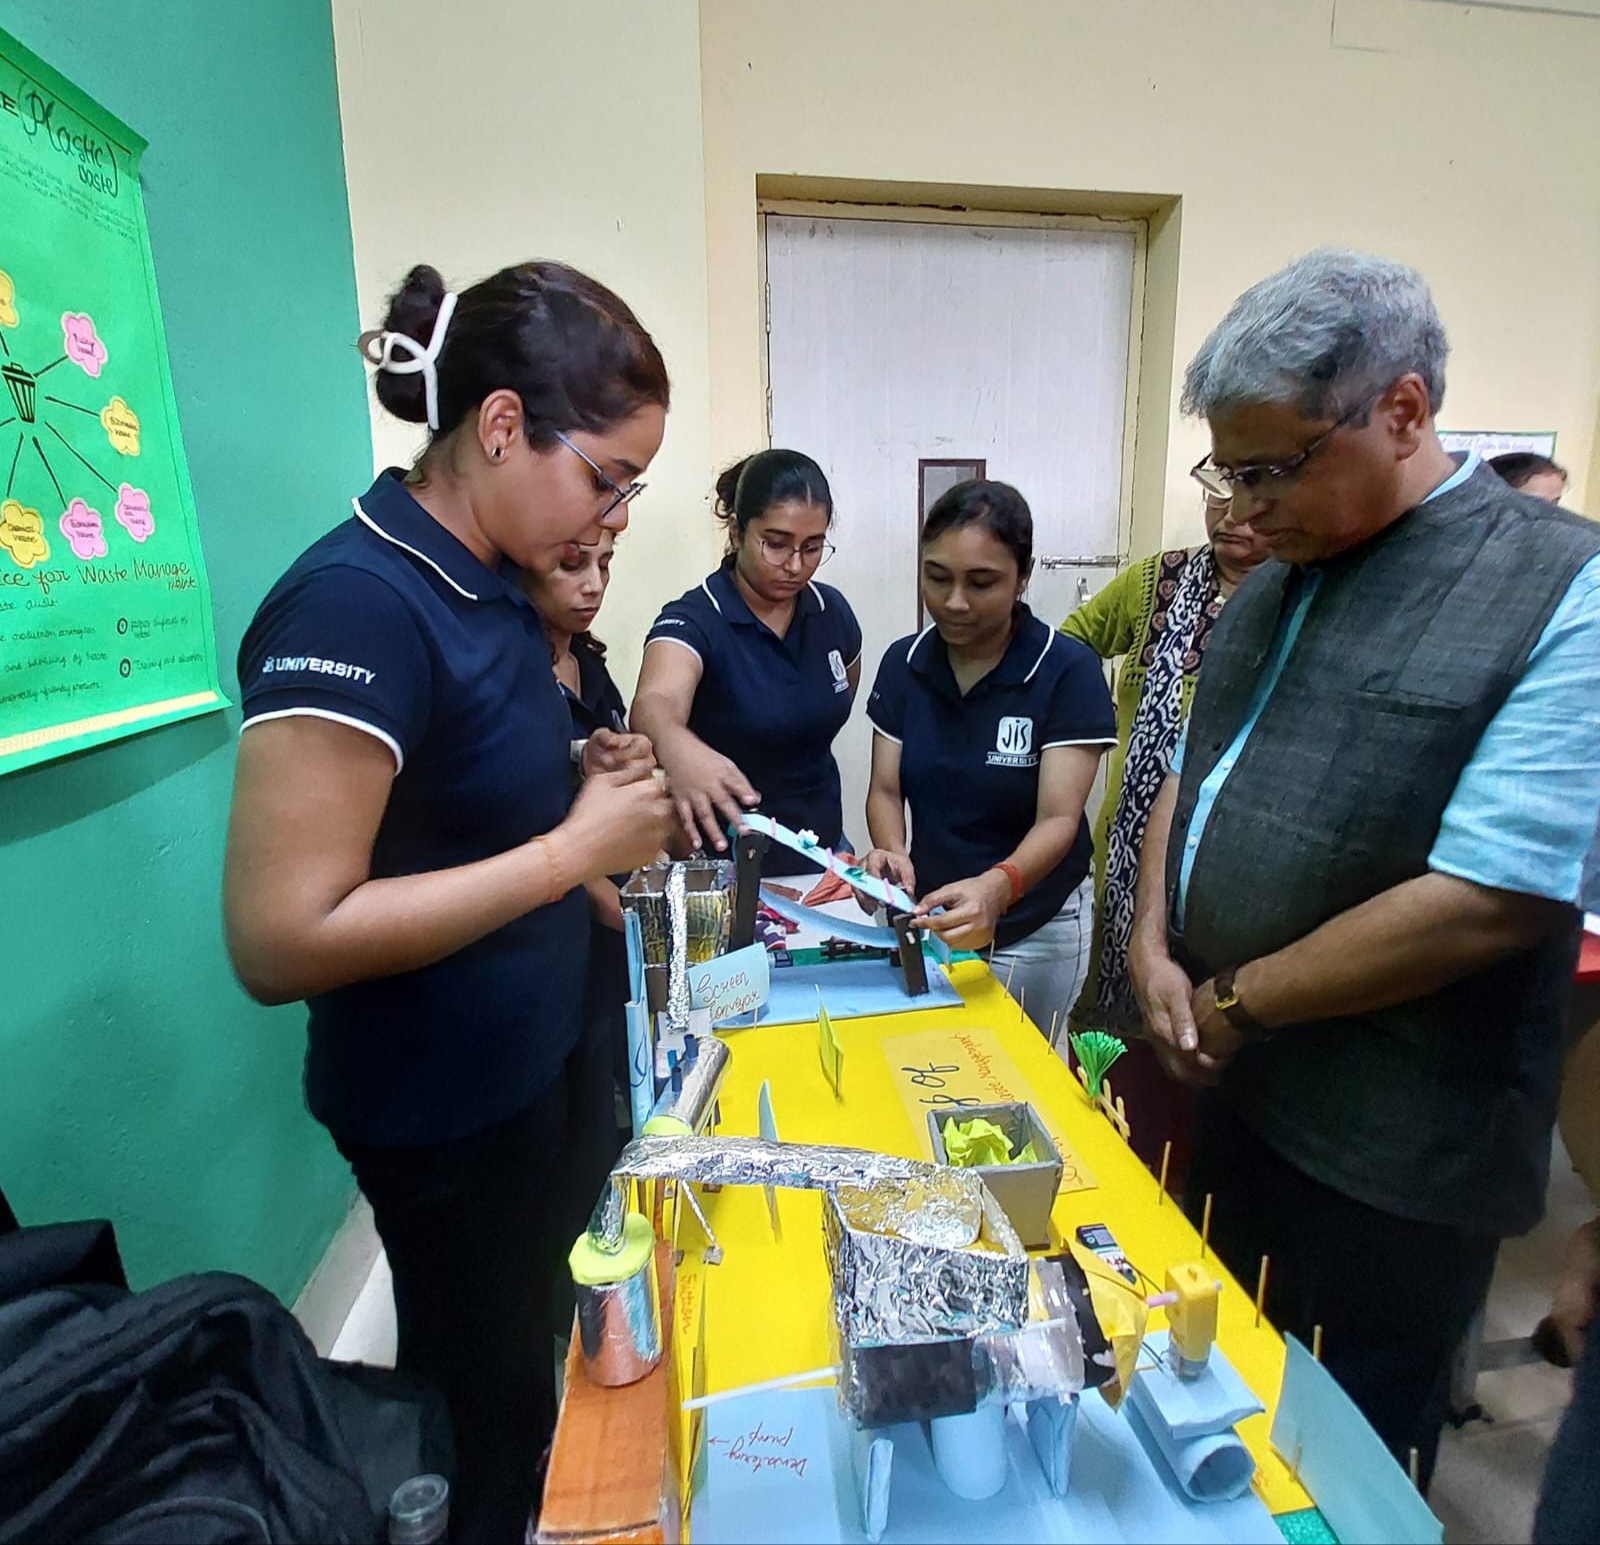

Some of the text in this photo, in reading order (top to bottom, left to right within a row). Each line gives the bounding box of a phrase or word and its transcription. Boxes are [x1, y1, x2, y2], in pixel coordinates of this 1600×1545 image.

[32, 569, 71, 595] for
[75, 564, 127, 585] Waste
[276, 656, 376, 685] UNIVERSITY
[987, 754, 1038, 766] UNIVERSITY
[695, 972, 750, 1003] Screen
